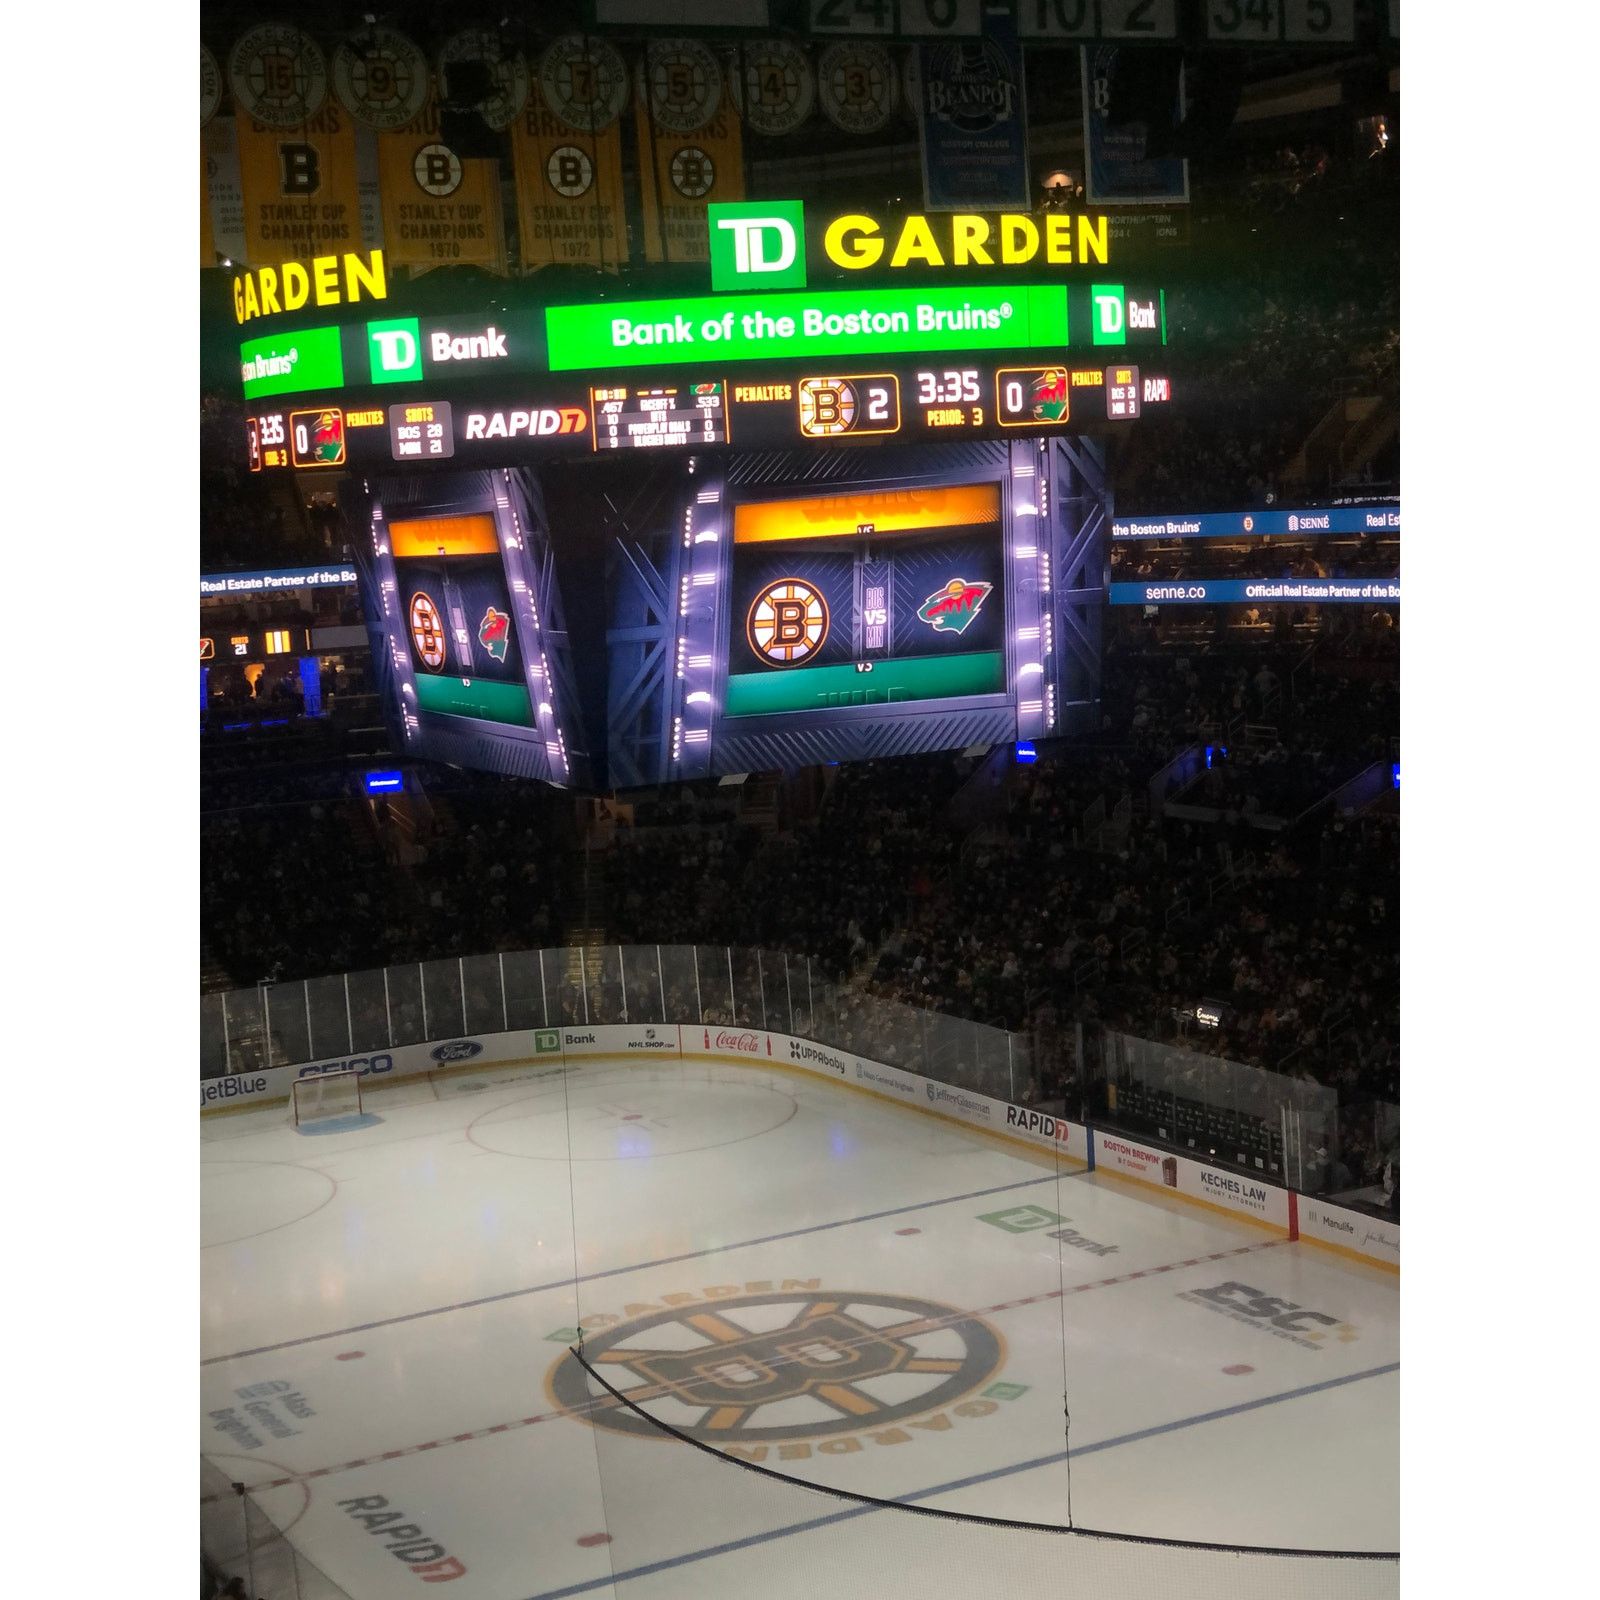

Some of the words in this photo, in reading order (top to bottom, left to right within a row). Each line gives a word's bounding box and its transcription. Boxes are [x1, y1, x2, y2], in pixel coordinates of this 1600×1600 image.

[267, 65, 291, 91] 15
[371, 66, 389, 93] 9
[576, 70, 592, 96] 7
[672, 72, 688, 98] 5
[763, 73, 781, 98] 4
[849, 72, 865, 98] 3
[928, 79, 1017, 121] BEANPOT
[427, 154, 451, 187] B
[559, 156, 582, 187] B
[261, 204, 316, 220] STANLEY
[322, 204, 347, 220] CUP
[400, 204, 453, 220] STANLEY
[459, 204, 482, 220] CUP
[535, 204, 585, 220] STANLEY
[590, 204, 611, 220] CUP
[261, 224, 350, 240] CHAMPIONS
[400, 224, 485, 240] CHAMPIONS
[535, 224, 614, 240] CHAMPIONS
[824, 214, 1109, 270] GARDEN
[561, 242, 590, 257] 1972
[717, 216, 797, 274] TD
[234, 249, 387, 325] GARDEN
[1095, 296, 1122, 333] TD
[1129, 302, 1156, 329] Bank
[611, 315, 694, 347] Bank
[701, 313, 735, 341] of
[742, 311, 796, 338] the
[803, 309, 909, 337] Boston
[372, 330, 416, 371] TD
[431, 327, 508, 362] Bank
[917, 371, 980, 404] 3:35
[1072, 370, 1103, 386] PENALTIES
[735, 385, 792, 402] PENALTIES
[869, 388, 888, 420] 2
[1006, 382, 1023, 412] 0
[347, 411, 384, 427] PENALTIES
[466, 408, 587, 440] RAPID7
[704, 419, 713, 431] 0
[927, 410, 965, 427] PERIOD:
[972, 407, 984, 426] 3
[296, 425, 308, 454] 0
[398, 426, 421, 440] BOS
[430, 440, 443, 454] 21
[1112, 525, 1129, 536] the
[1131, 523, 1165, 535] Boston
[1300, 515, 1330, 529] SENNÉ
[1367, 514, 1386, 526] Real
[201, 580, 225, 592] Real
[228, 578, 263, 590] Estate
[264, 575, 305, 587] Partner
[307, 573, 319, 584] of
[321, 572, 340, 583] the
[1146, 586, 1206, 599] senne.co
[1246, 584, 1282, 597] Official
[1284, 585, 1300, 597] Real
[1302, 585, 1328, 597] Estate
[1329, 585, 1360, 597] Partner
[1362, 584, 1371, 597] of
[1372, 584, 1387, 597] the
[866, 587, 884, 610] BOS
[864, 609, 887, 626] VS
[234, 644, 248, 655] 21
[440, 1044, 473, 1061] Ford
[537, 1033, 558, 1048] TD
[565, 1034, 596, 1045] Bank
[801, 1047, 845, 1074] UPPAbaby
[201, 1075, 267, 1105] jetBlue
[1006, 1105, 1069, 1141] RAPID7
[1103, 1140, 1131, 1156] BOSTON
[1200, 1171, 1239, 1193] KECHES
[1242, 1184, 1267, 1202] LAW
[1322, 1216, 1354, 1234] Manulife
[1046, 1228, 1120, 1257] Bank
[579, 1278, 822, 1329] GARDEN
[724, 1399, 1000, 1462] GARDEN
[336, 1494, 467, 1583] RAPID7
